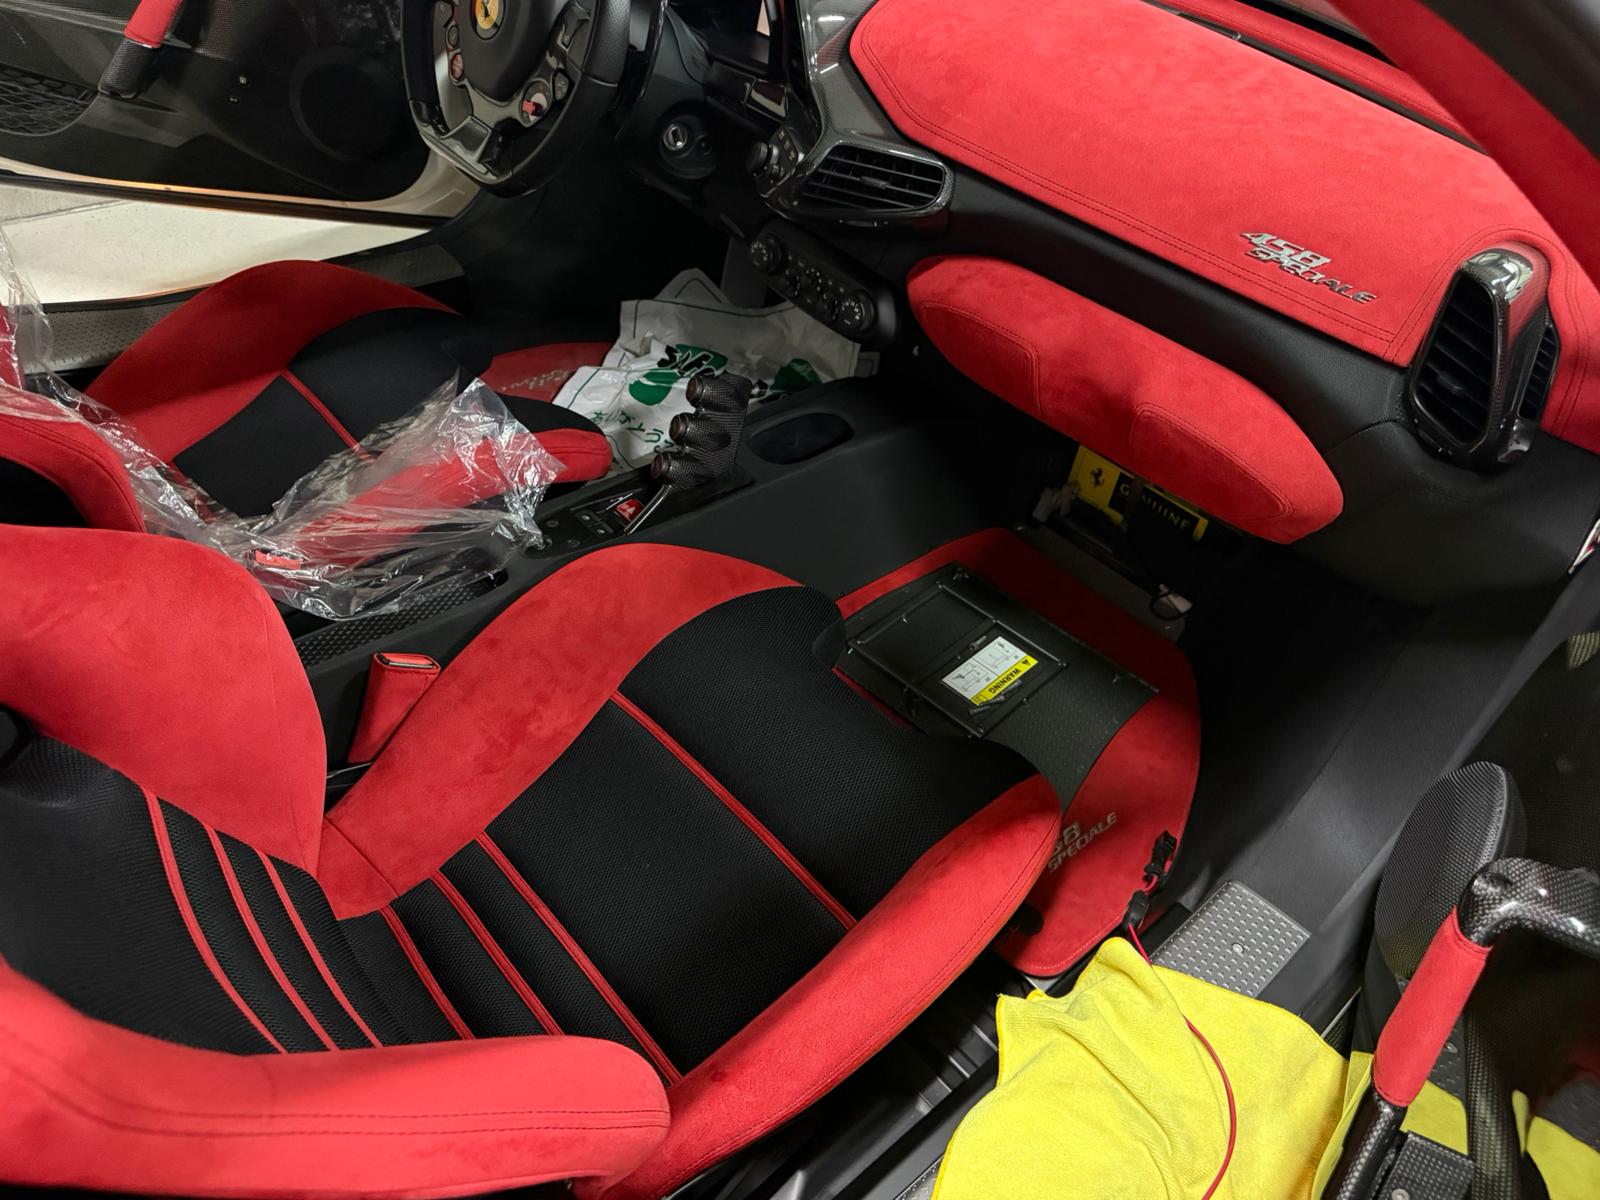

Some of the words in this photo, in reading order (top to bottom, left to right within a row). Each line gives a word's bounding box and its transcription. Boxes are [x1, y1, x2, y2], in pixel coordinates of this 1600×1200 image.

[1240, 232, 1332, 268] 458
[1244, 248, 1377, 304] SPECIALE
[988, 668, 1021, 694] WARNING
[1047, 811, 1118, 874] SPECIALE
